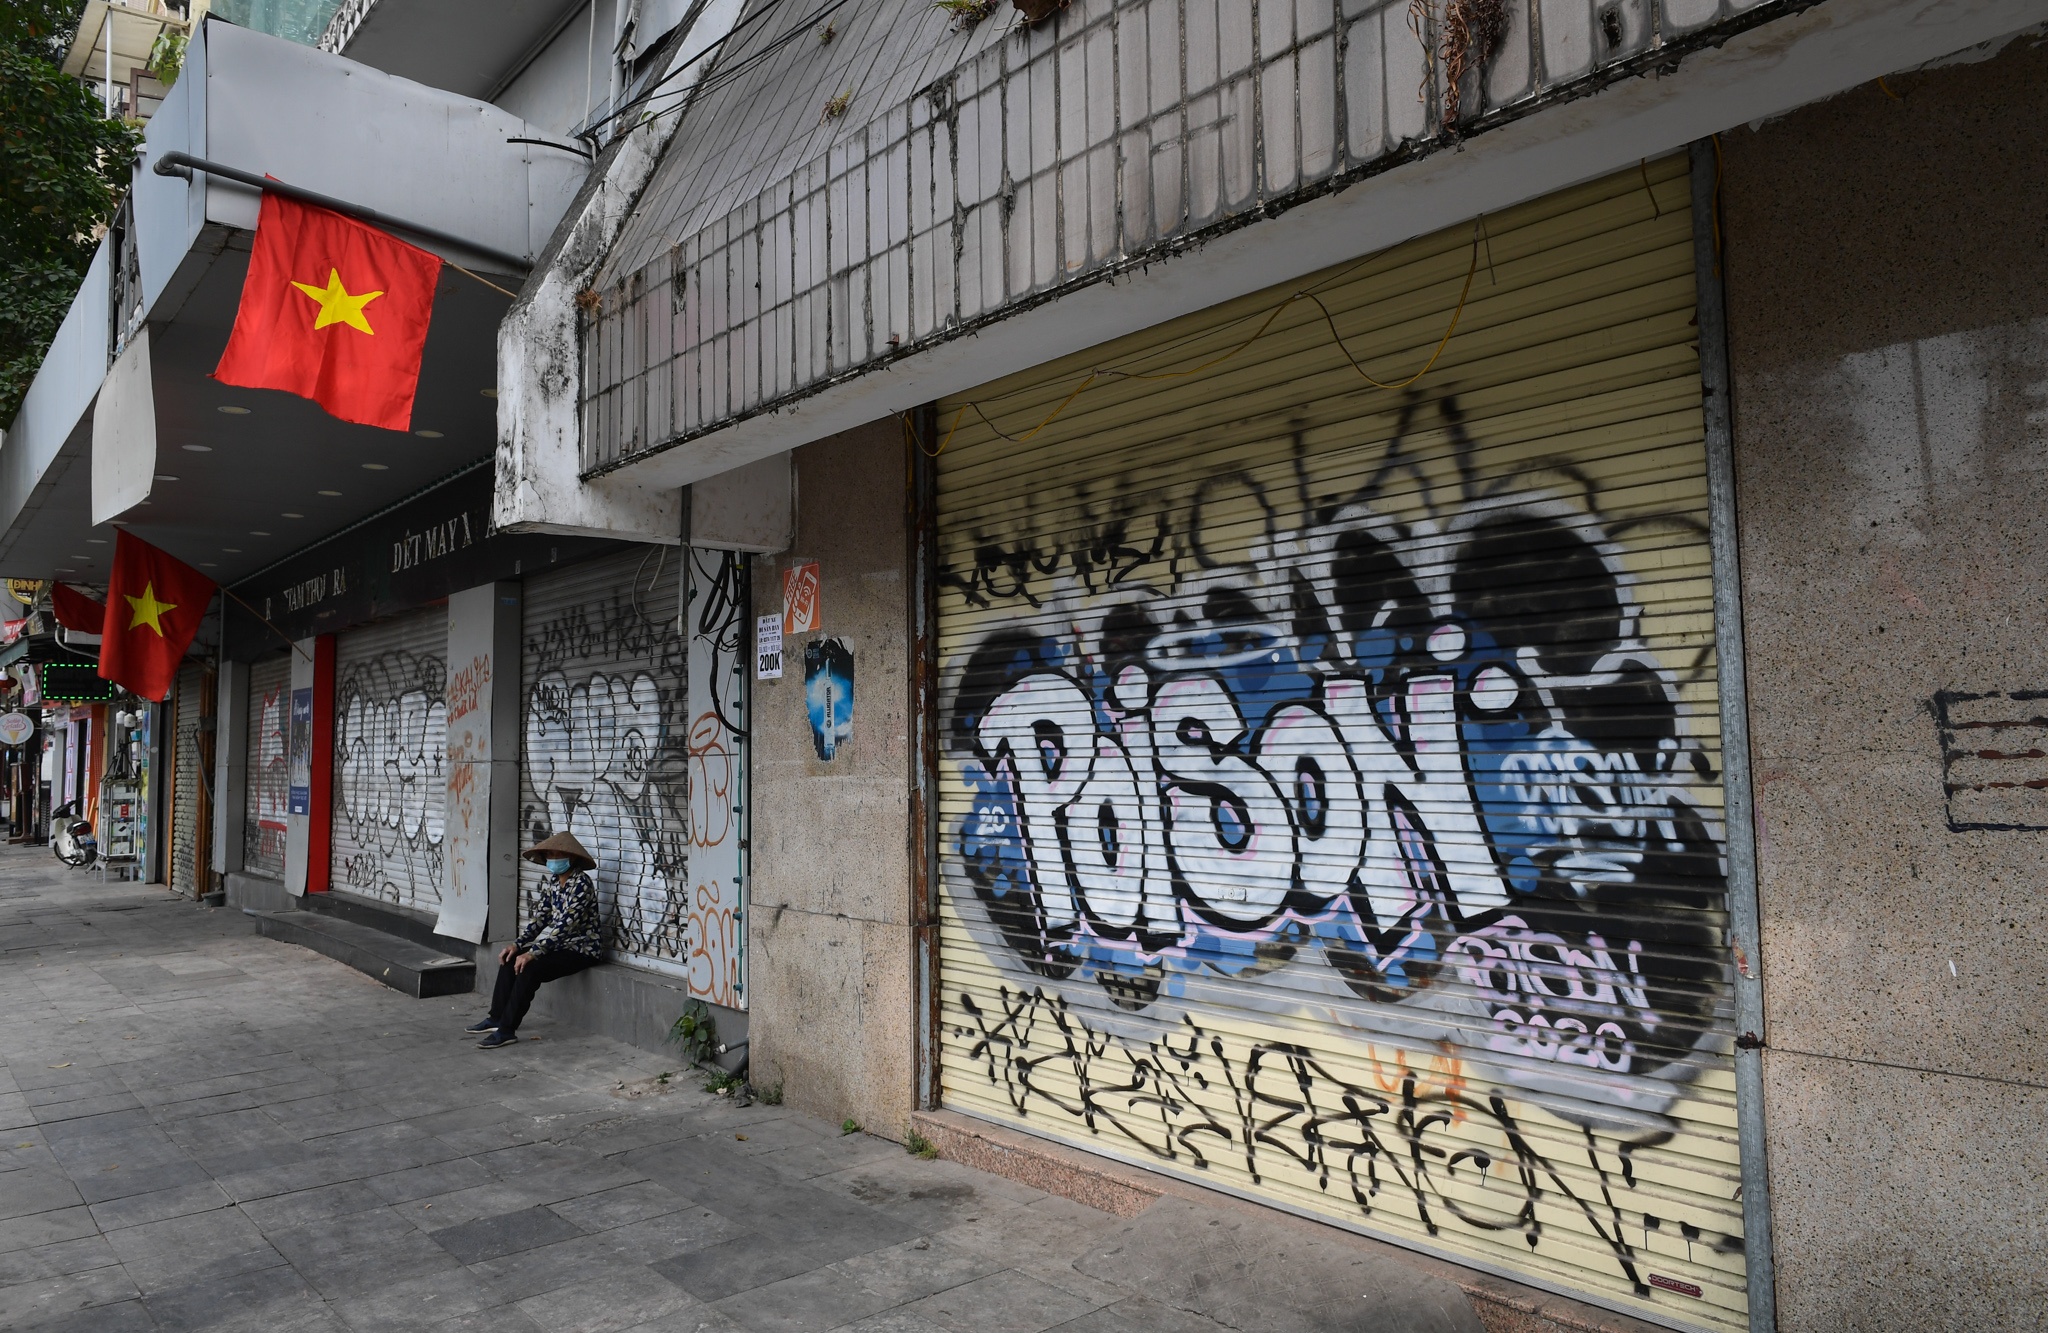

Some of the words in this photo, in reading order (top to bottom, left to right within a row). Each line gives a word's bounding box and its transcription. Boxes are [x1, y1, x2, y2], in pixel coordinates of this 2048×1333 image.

[424, 518, 458, 561] MAY
[760, 653, 780, 672] 200K
[1488, 1009, 1638, 1073] 2020
[1651, 1275, 1697, 1292] DOORTECH
